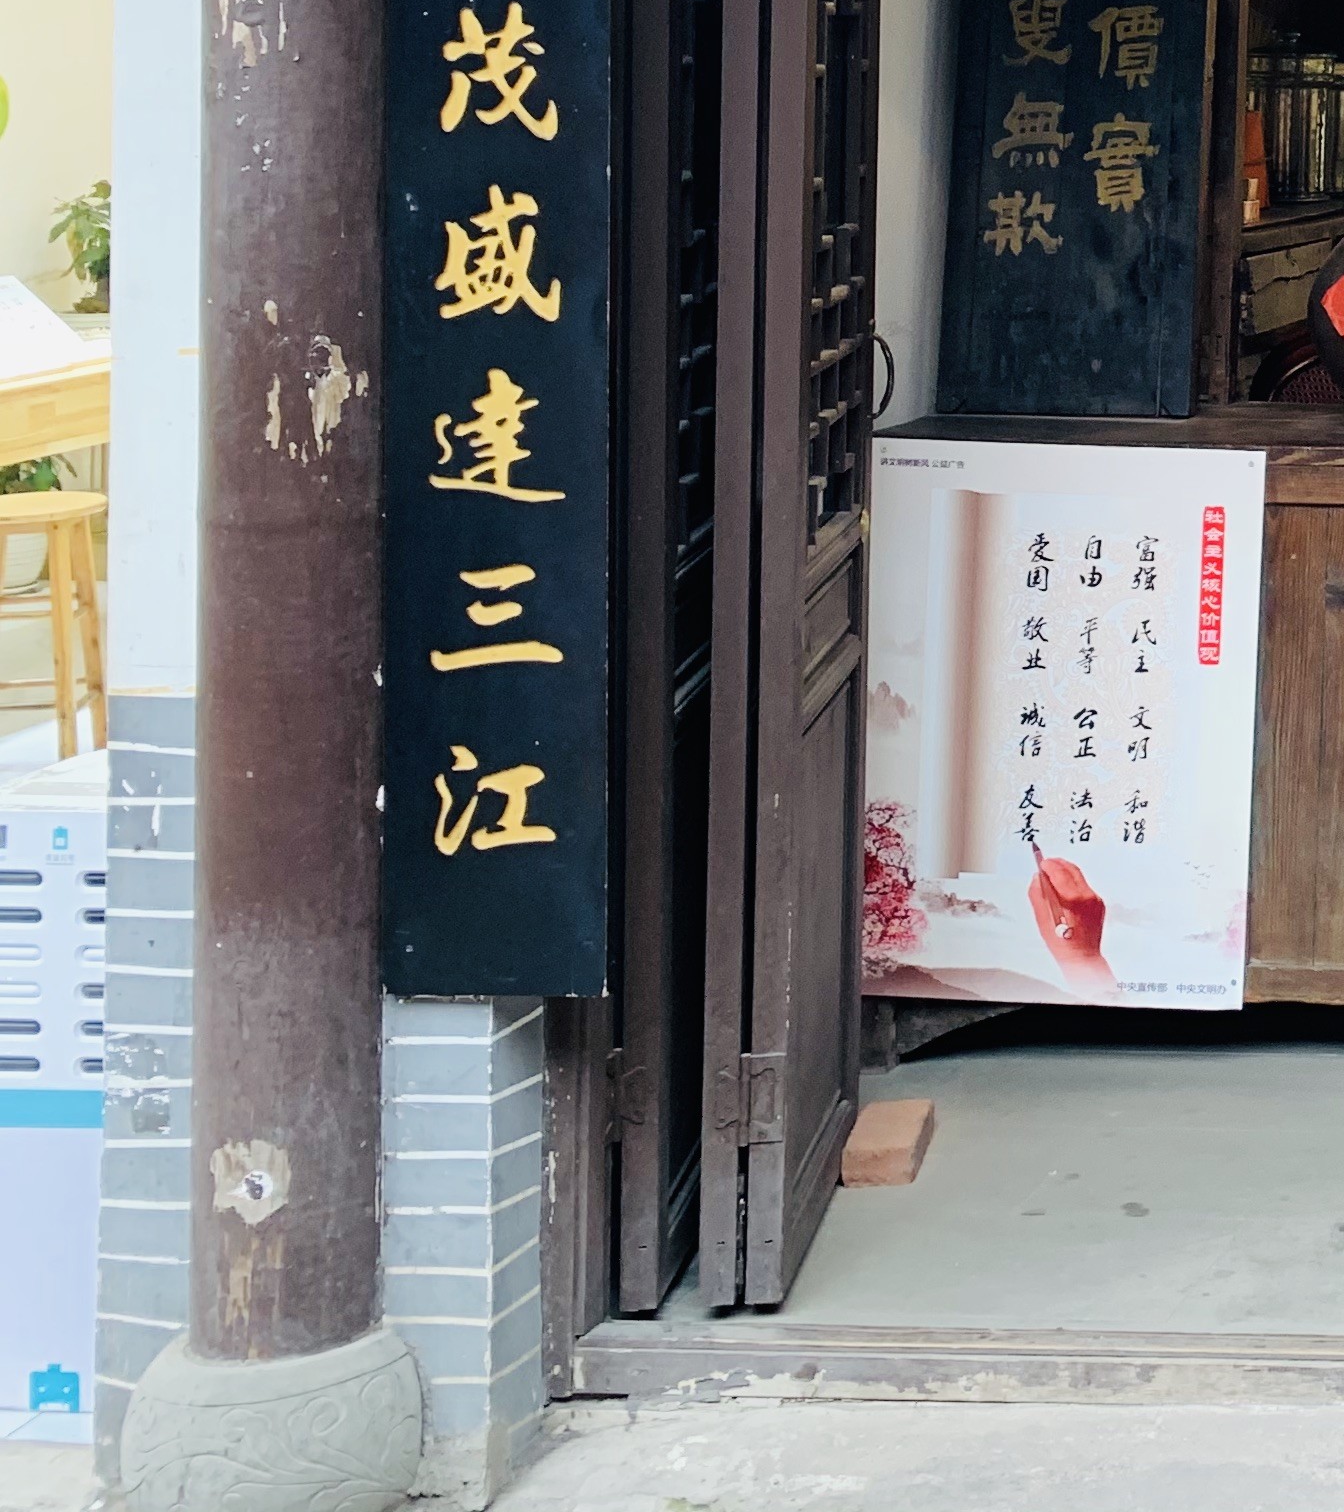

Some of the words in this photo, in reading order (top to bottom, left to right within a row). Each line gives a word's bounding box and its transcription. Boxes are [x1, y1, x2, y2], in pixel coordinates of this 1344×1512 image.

[1026, 532, 1055, 592] 爱国
[1079, 535, 1103, 588] 自由
[1131, 535, 1159, 591] 富强
[1199, 510, 1225, 663] 社会主义核心价值观
[1022, 616, 1049, 670] 敬业
[1078, 617, 1099, 675] 平等
[1131, 619, 1157, 673] 民主
[1073, 707, 1098, 759] 公正
[1127, 706, 1152, 762] 文明
[1014, 784, 1044, 842] 友善
[1070, 788, 1094, 844] 法治
[1117, 981, 1169, 993] 中央宣传部
